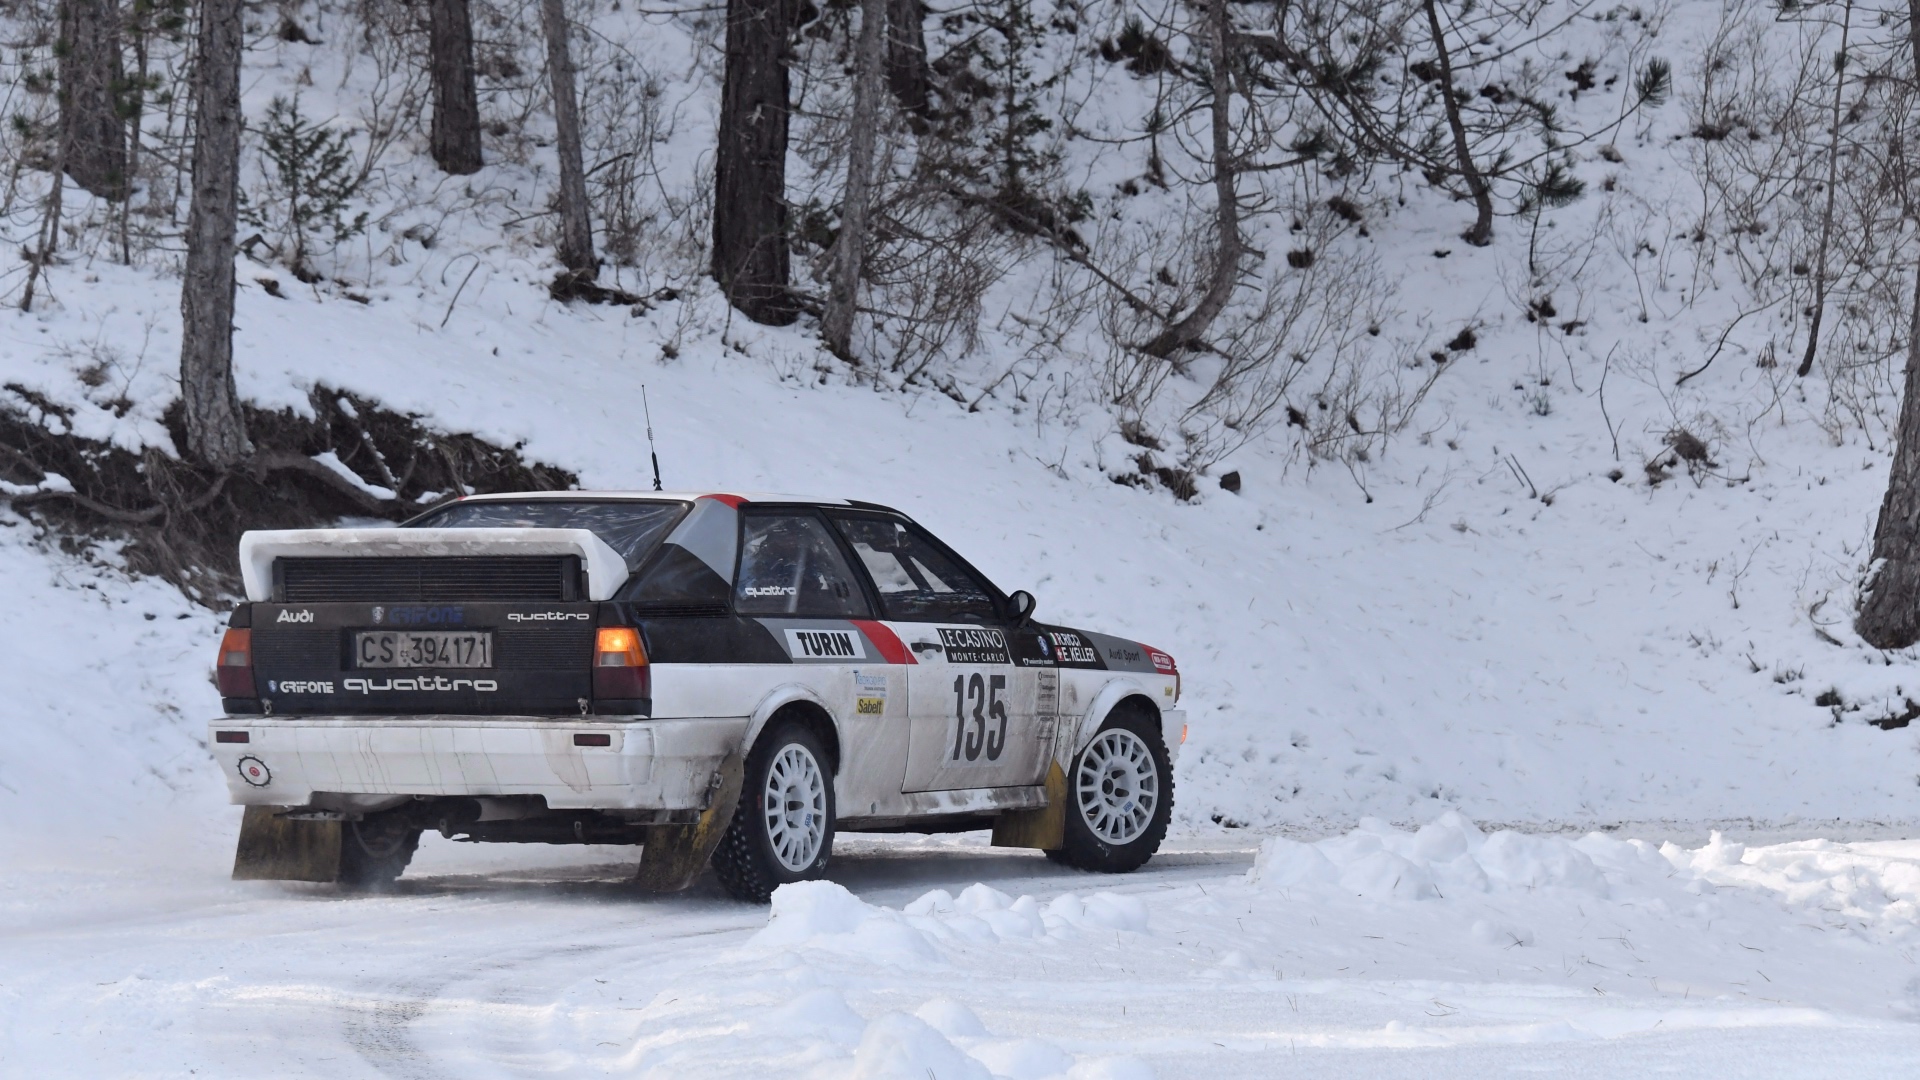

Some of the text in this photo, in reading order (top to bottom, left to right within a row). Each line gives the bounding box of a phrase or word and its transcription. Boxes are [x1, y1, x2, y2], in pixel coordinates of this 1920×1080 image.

[745, 585, 797, 598] quattro
[276, 609, 314, 623] Audi
[389, 606, 464, 623] GRIFONE
[507, 611, 590, 622] quattro
[796, 632, 856, 656] TURIN
[939, 630, 1003, 649] LE CASINO
[361, 635, 487, 664] CS 394171
[1070, 647, 1097, 662] KELLER
[1109, 648, 1141, 663] Audi Sport
[279, 680, 334, 694] GRIFONE
[343, 675, 498, 695] quattro
[858, 698, 882, 714] Sabelt
[952, 672, 1007, 761] 135
